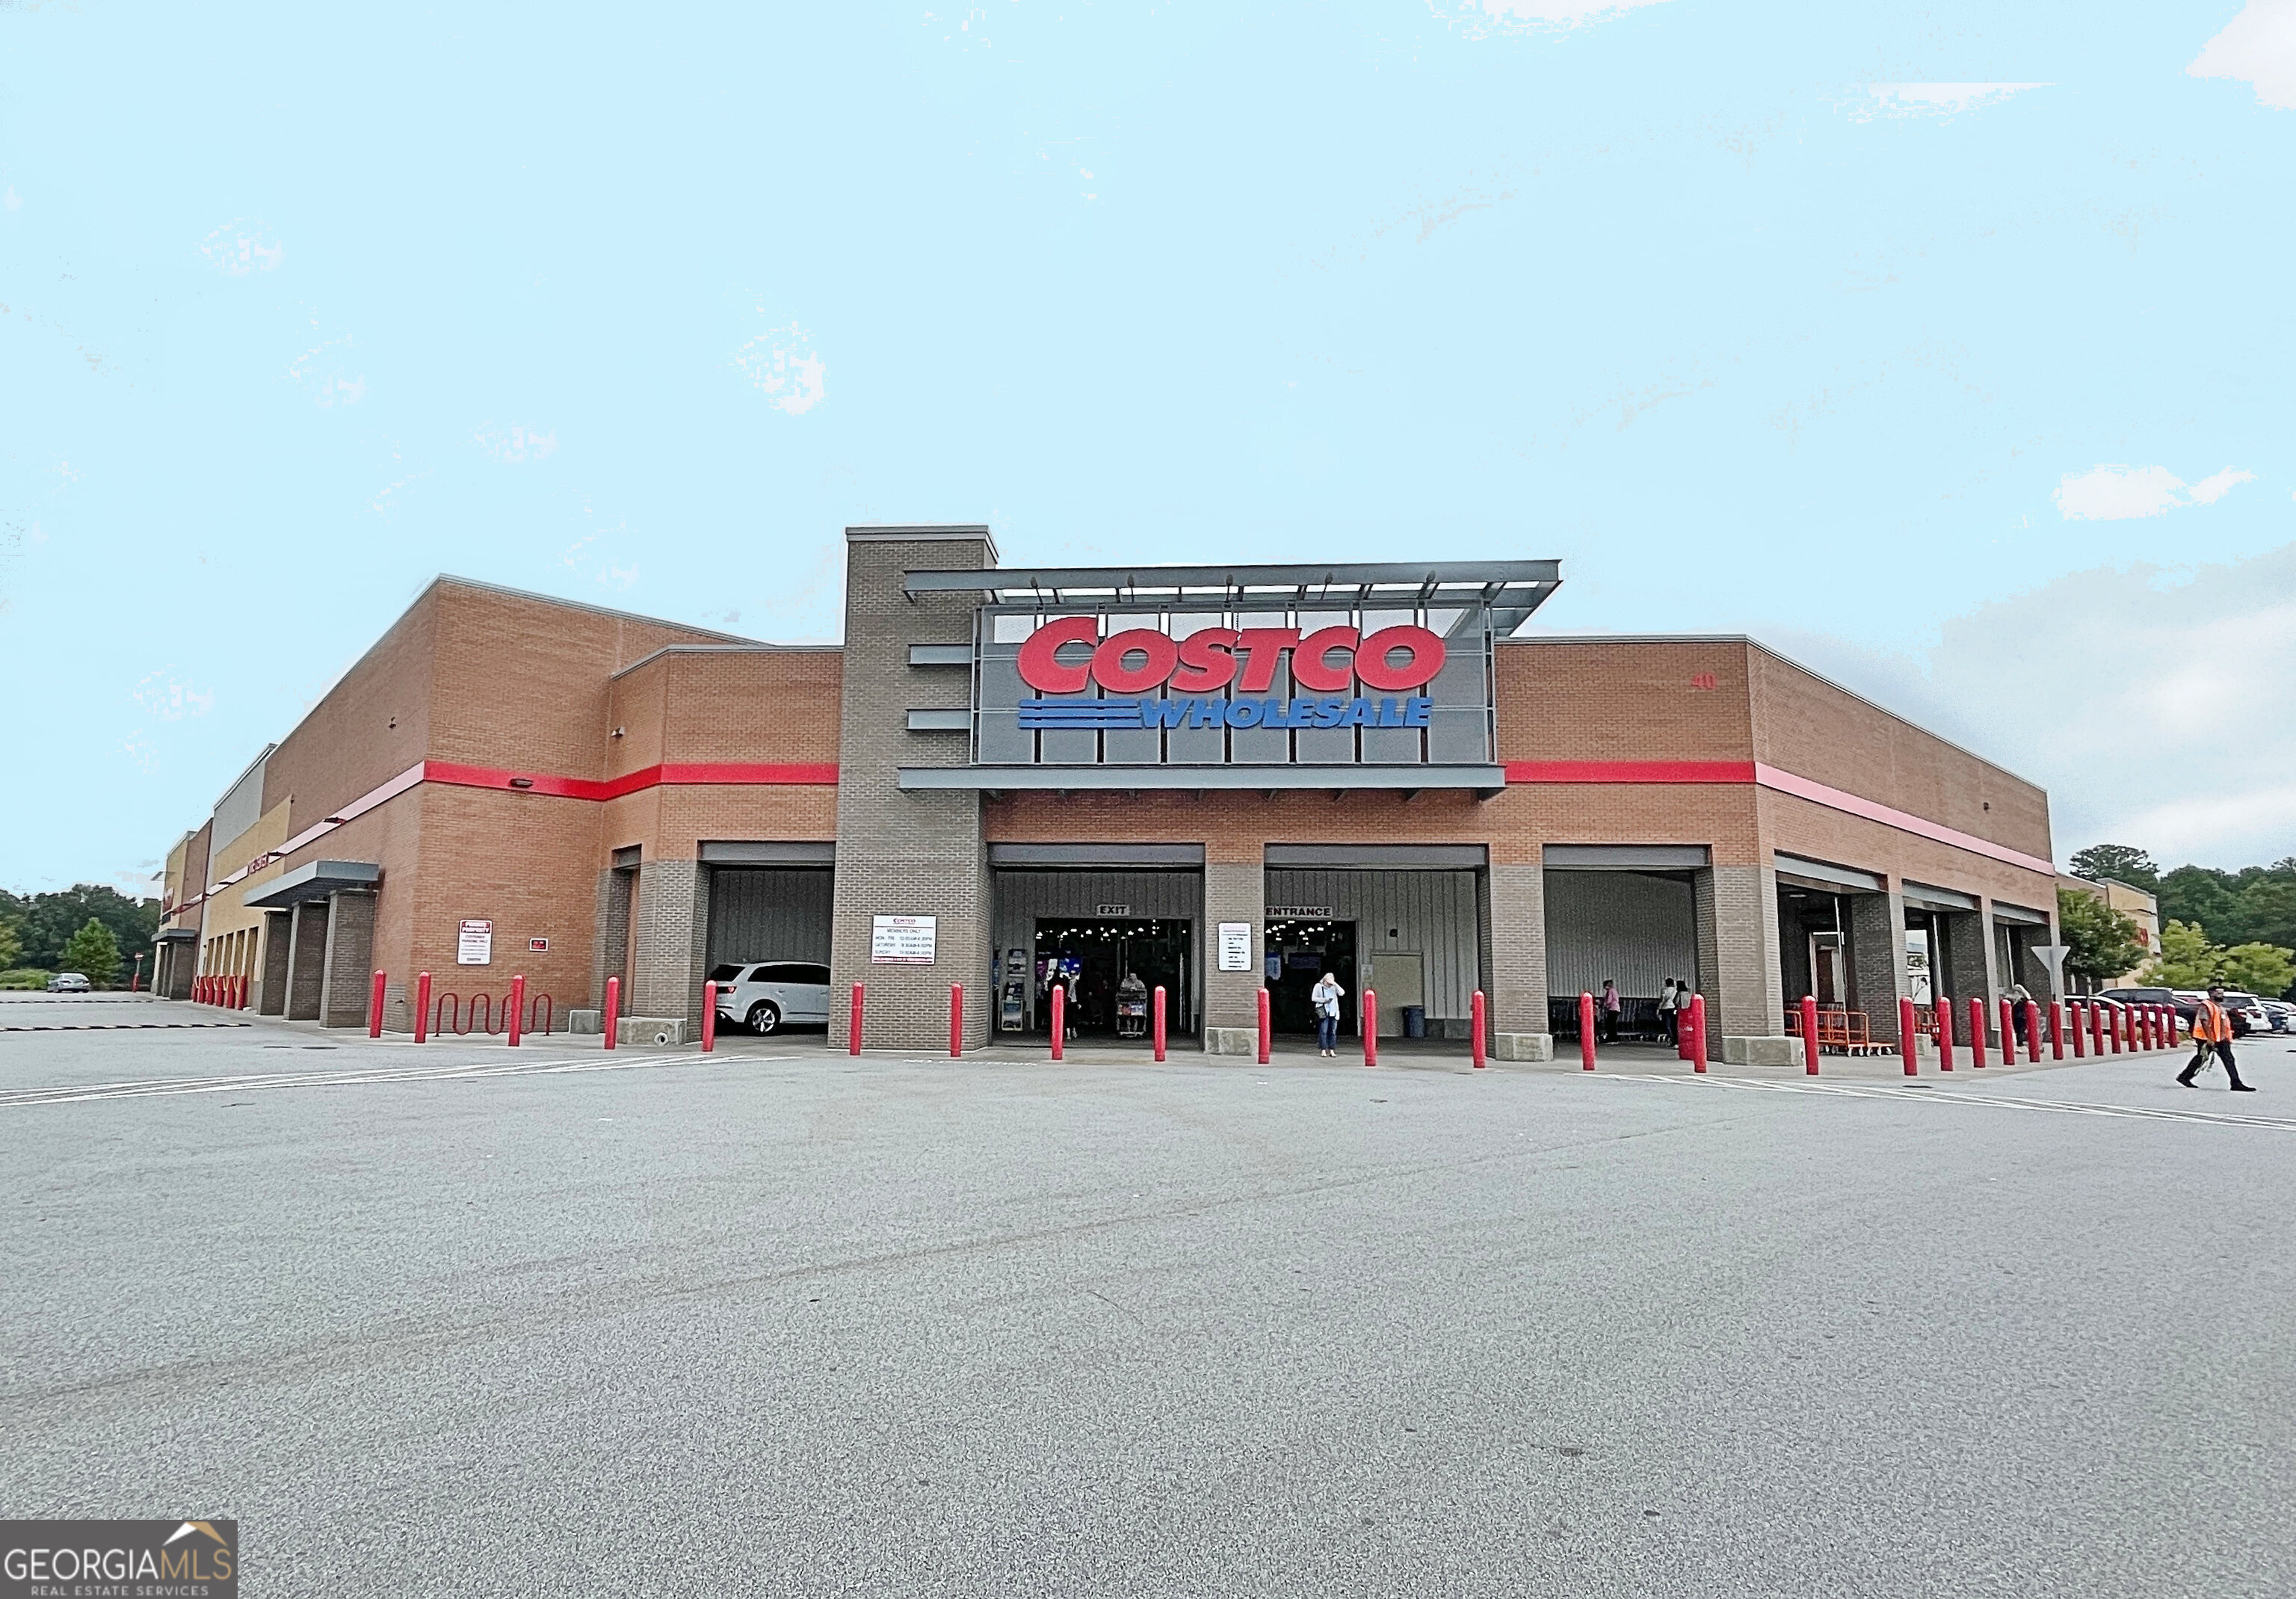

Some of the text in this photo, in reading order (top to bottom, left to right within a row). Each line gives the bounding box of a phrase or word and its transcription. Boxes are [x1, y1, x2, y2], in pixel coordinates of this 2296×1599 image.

[1018, 616, 1446, 694] COSTCO
[1140, 697, 1434, 729] WHOLESALE
[1100, 905, 1127, 914] EXIT
[1265, 907, 1331, 916] ENTRANCE
